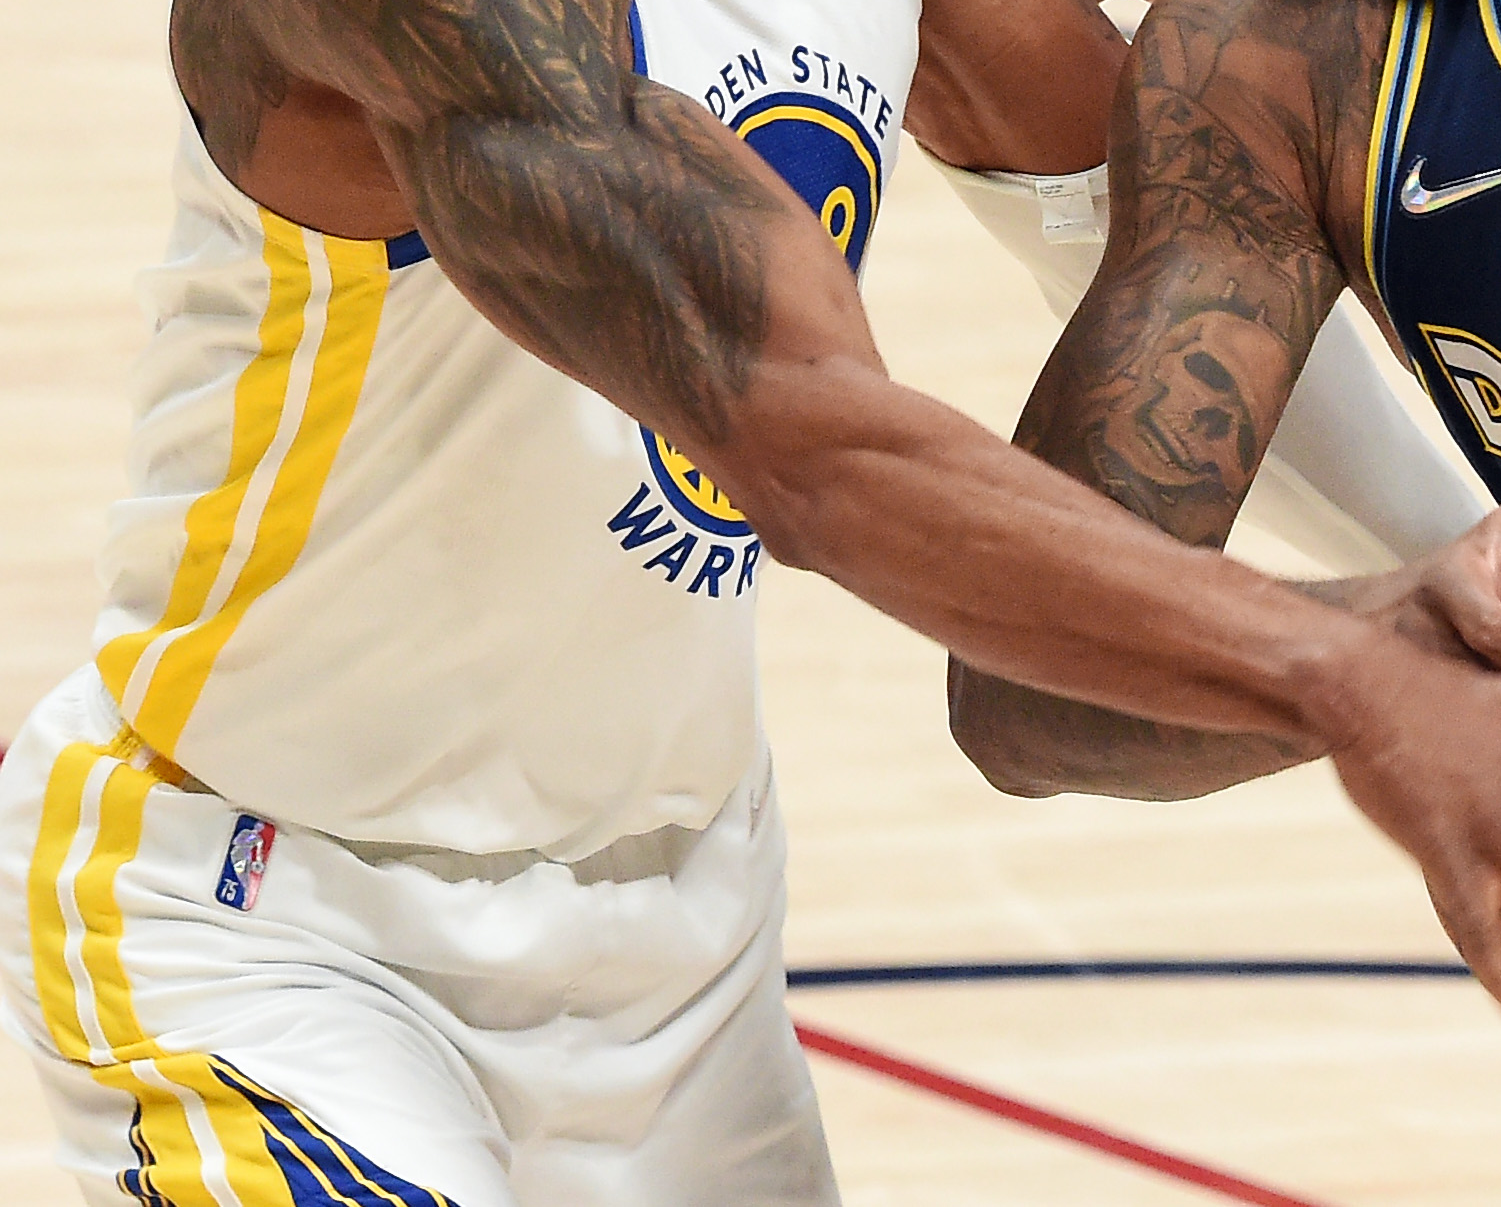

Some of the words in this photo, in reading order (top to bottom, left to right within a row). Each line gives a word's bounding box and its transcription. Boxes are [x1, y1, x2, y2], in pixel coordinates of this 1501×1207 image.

[705, 48, 768, 120] DEN
[791, 45, 893, 140] STATE
[607, 481, 761, 598] WARR
[220, 878, 240, 902] 75
